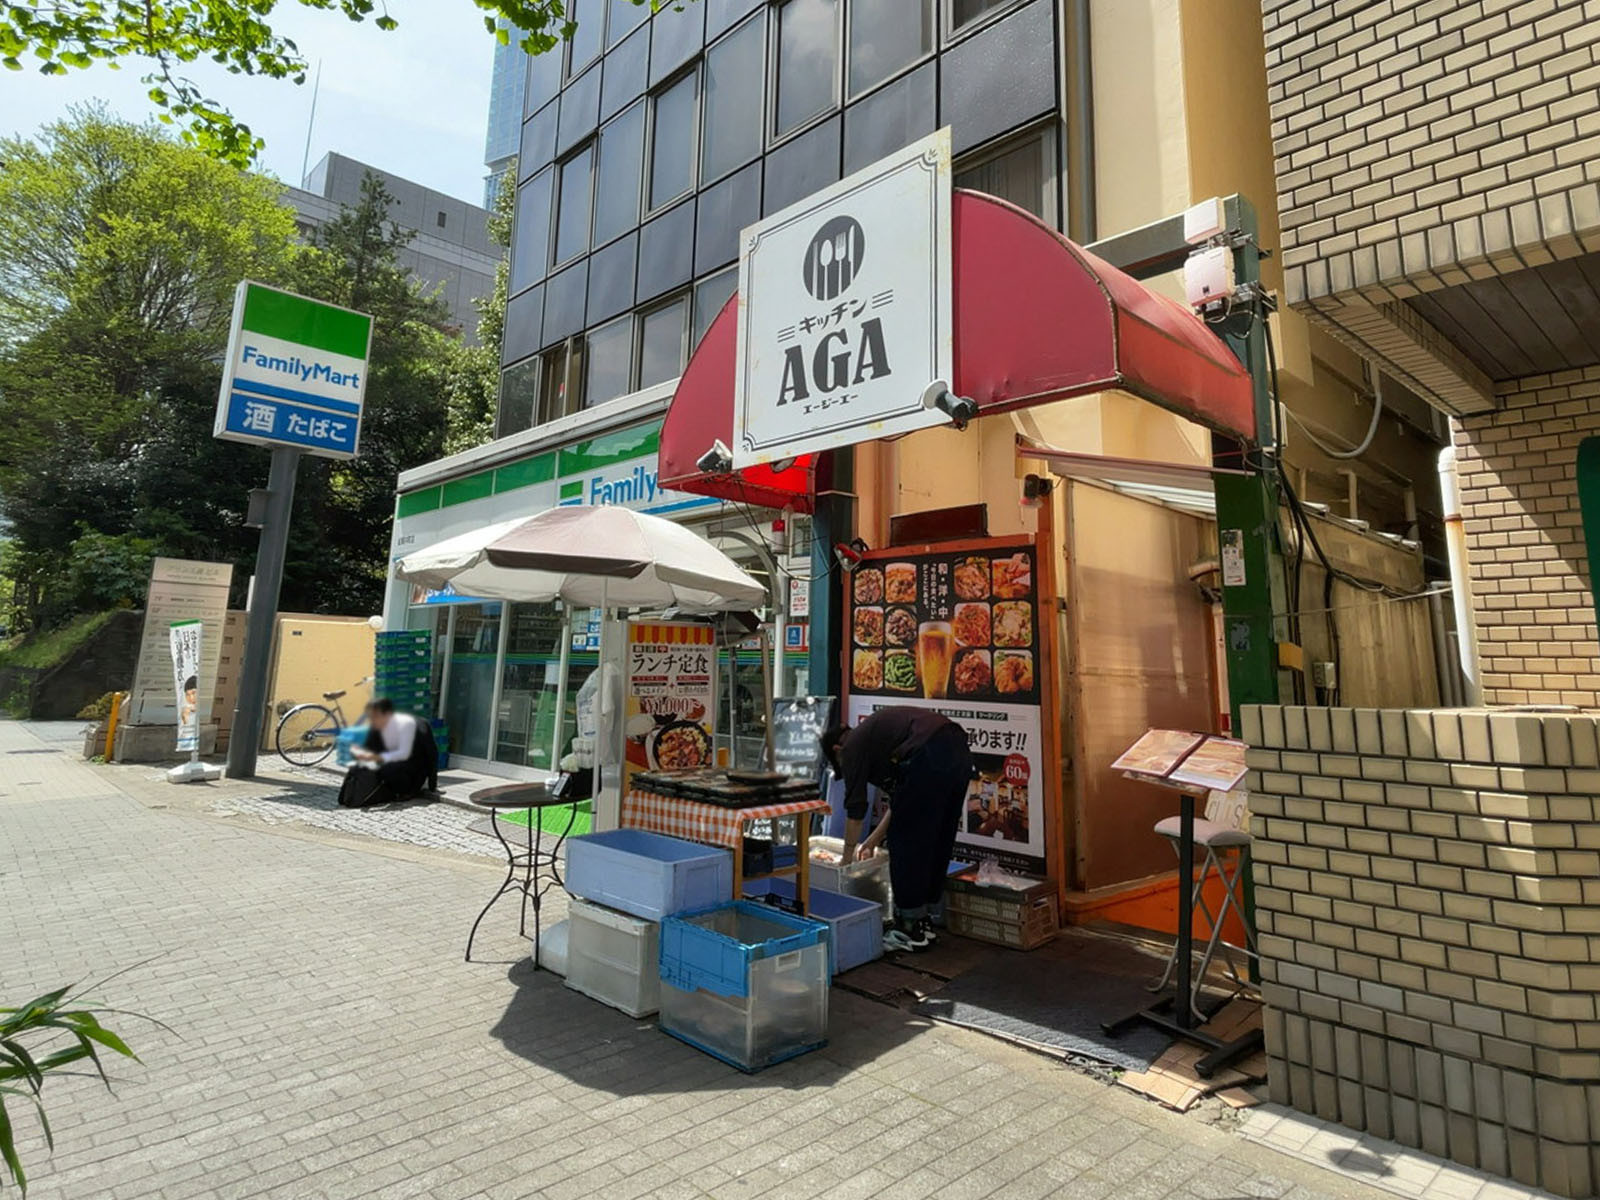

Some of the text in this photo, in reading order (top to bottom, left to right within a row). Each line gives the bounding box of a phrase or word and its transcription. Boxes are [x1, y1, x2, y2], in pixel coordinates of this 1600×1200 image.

[798, 299, 867, 335] キッチン
[242, 345, 360, 390] FamilyMart
[776, 317, 892, 407] AGA
[242, 400, 347, 443] 酒 たばこ
[802, 393, 859, 414] エージーエー
[590, 466, 664, 506] Family
[633, 653, 709, 674] ランチ定食
